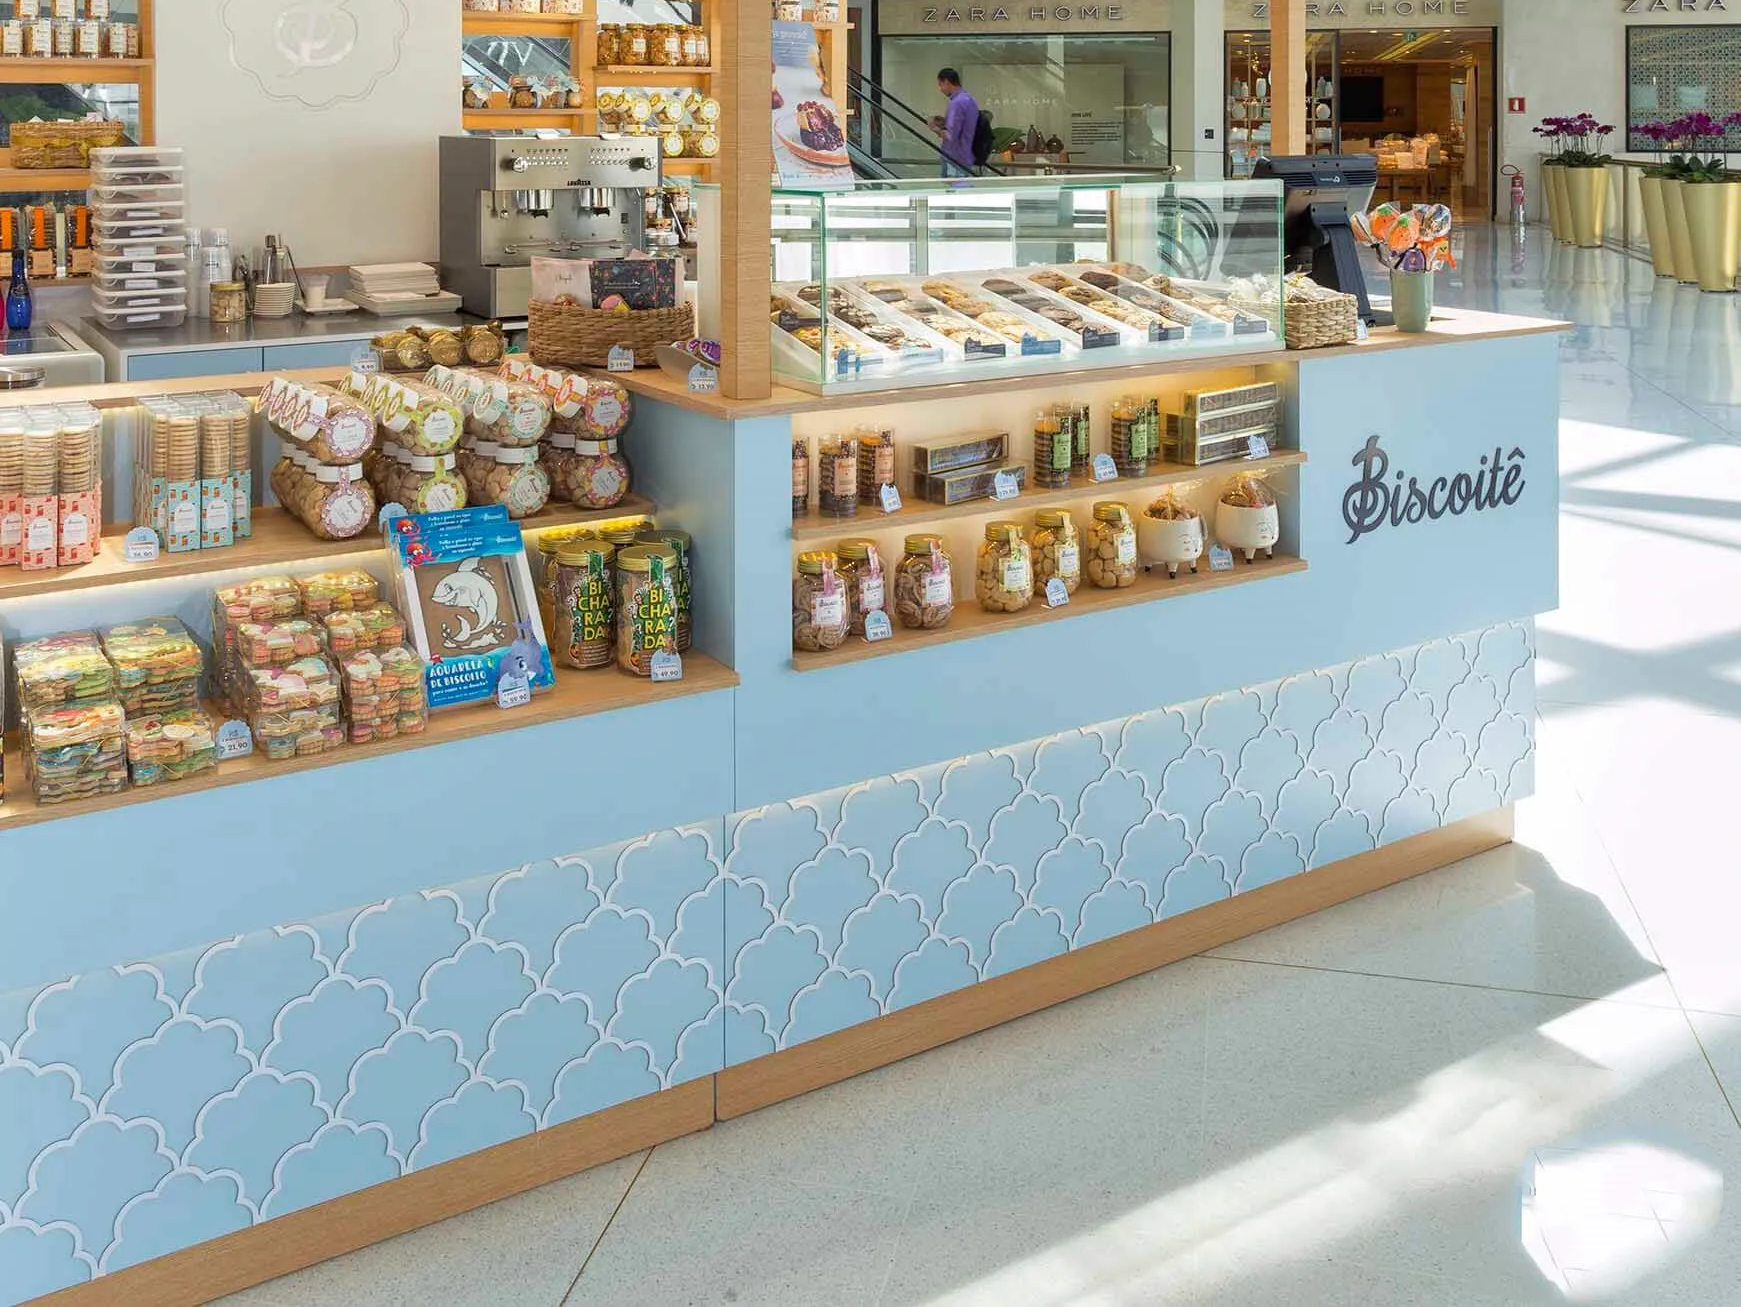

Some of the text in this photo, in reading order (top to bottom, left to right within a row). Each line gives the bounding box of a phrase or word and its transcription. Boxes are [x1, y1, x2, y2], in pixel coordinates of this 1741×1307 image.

[923, 5, 1122, 23] ZARA HOME
[1253, 0, 1469, 18] ZRA HOME
[1342, 435, 1526, 544] Biscoitê
[589, 581, 602, 596] BI
[650, 589, 663, 603] BI
[579, 595, 610, 611] CHA
[639, 603, 672, 619] CHA
[585, 611, 606, 626] RA
[645, 619, 666, 634] RA
[584, 626, 606, 641] DA
[644, 634, 666, 650] DA
